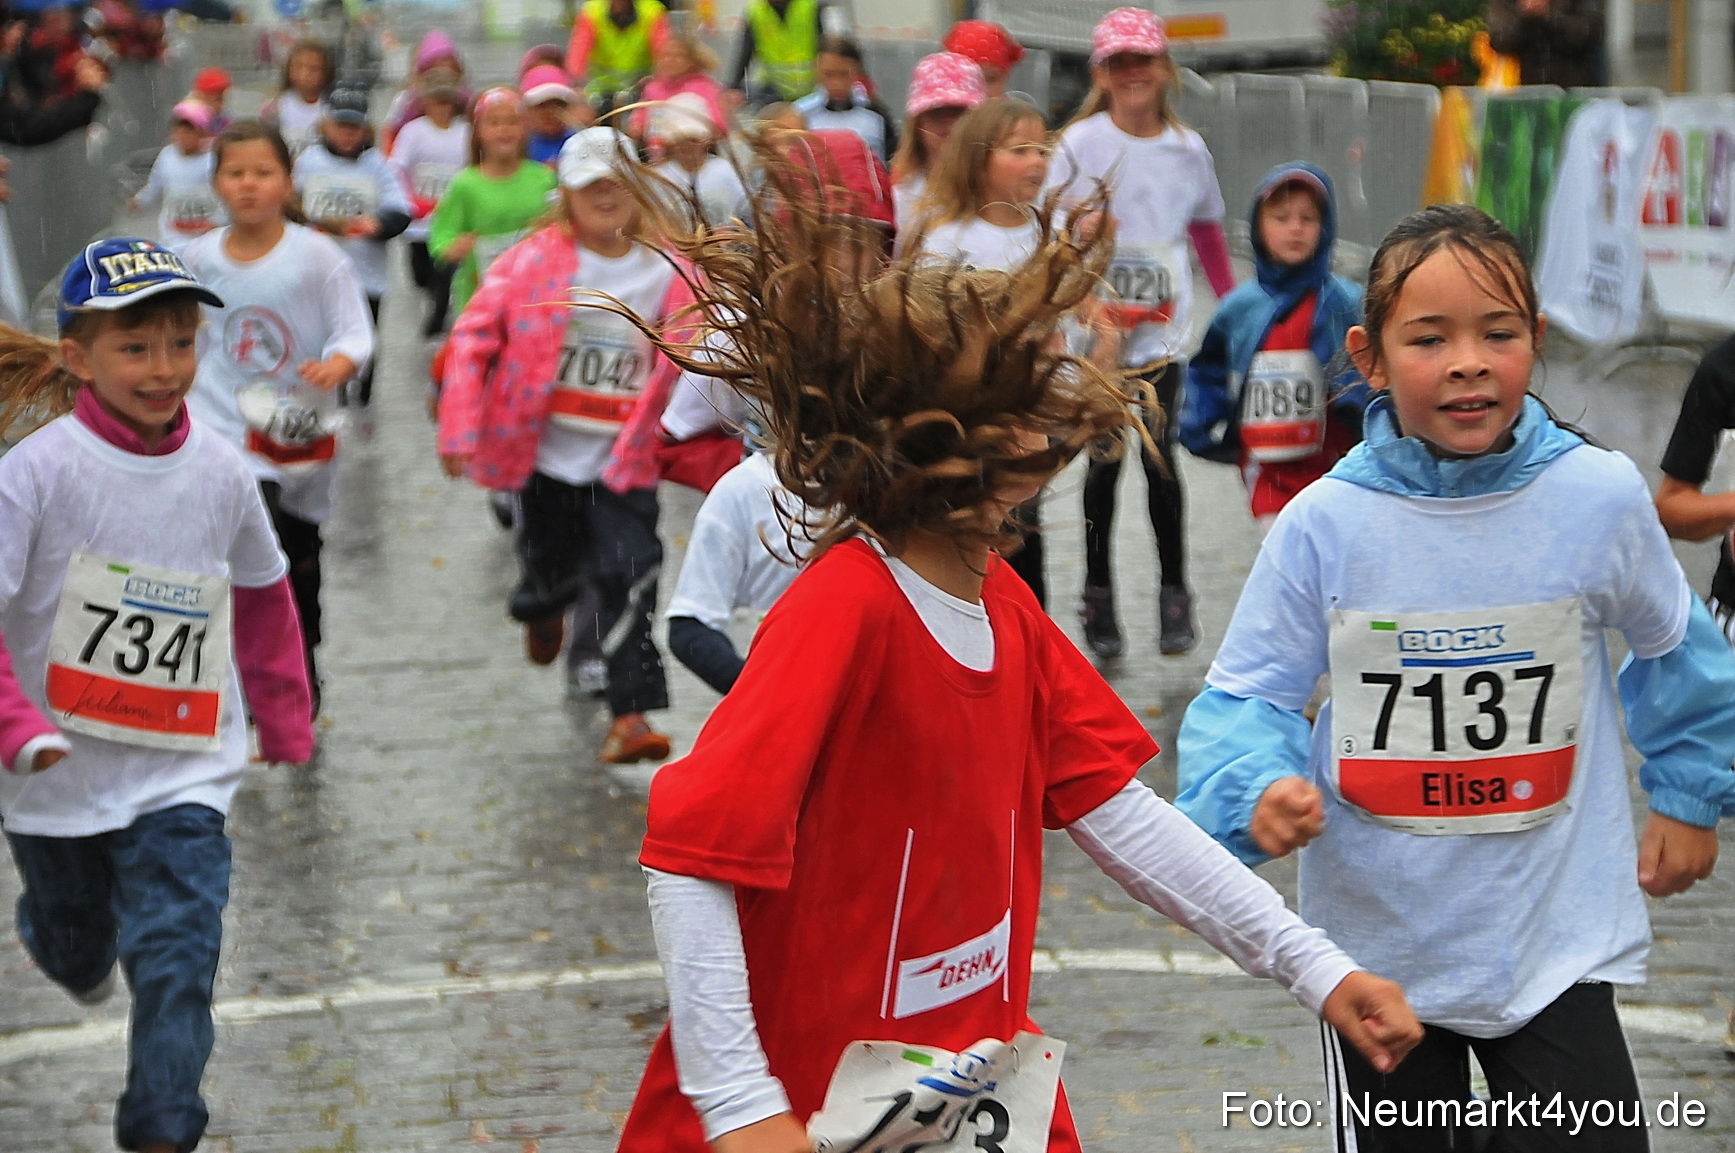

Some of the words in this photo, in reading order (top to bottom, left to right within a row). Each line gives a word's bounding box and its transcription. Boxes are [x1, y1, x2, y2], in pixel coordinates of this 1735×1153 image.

[1112, 265, 1172, 301] 020
[558, 346, 641, 391] 7042
[124, 577, 202, 605] BOCK
[77, 601, 208, 685] 7341
[1399, 625, 1505, 652] BOCK
[1361, 664, 1556, 753] 7137
[1421, 771, 1508, 807] Elisa
[938, 946, 996, 990] DEHN
